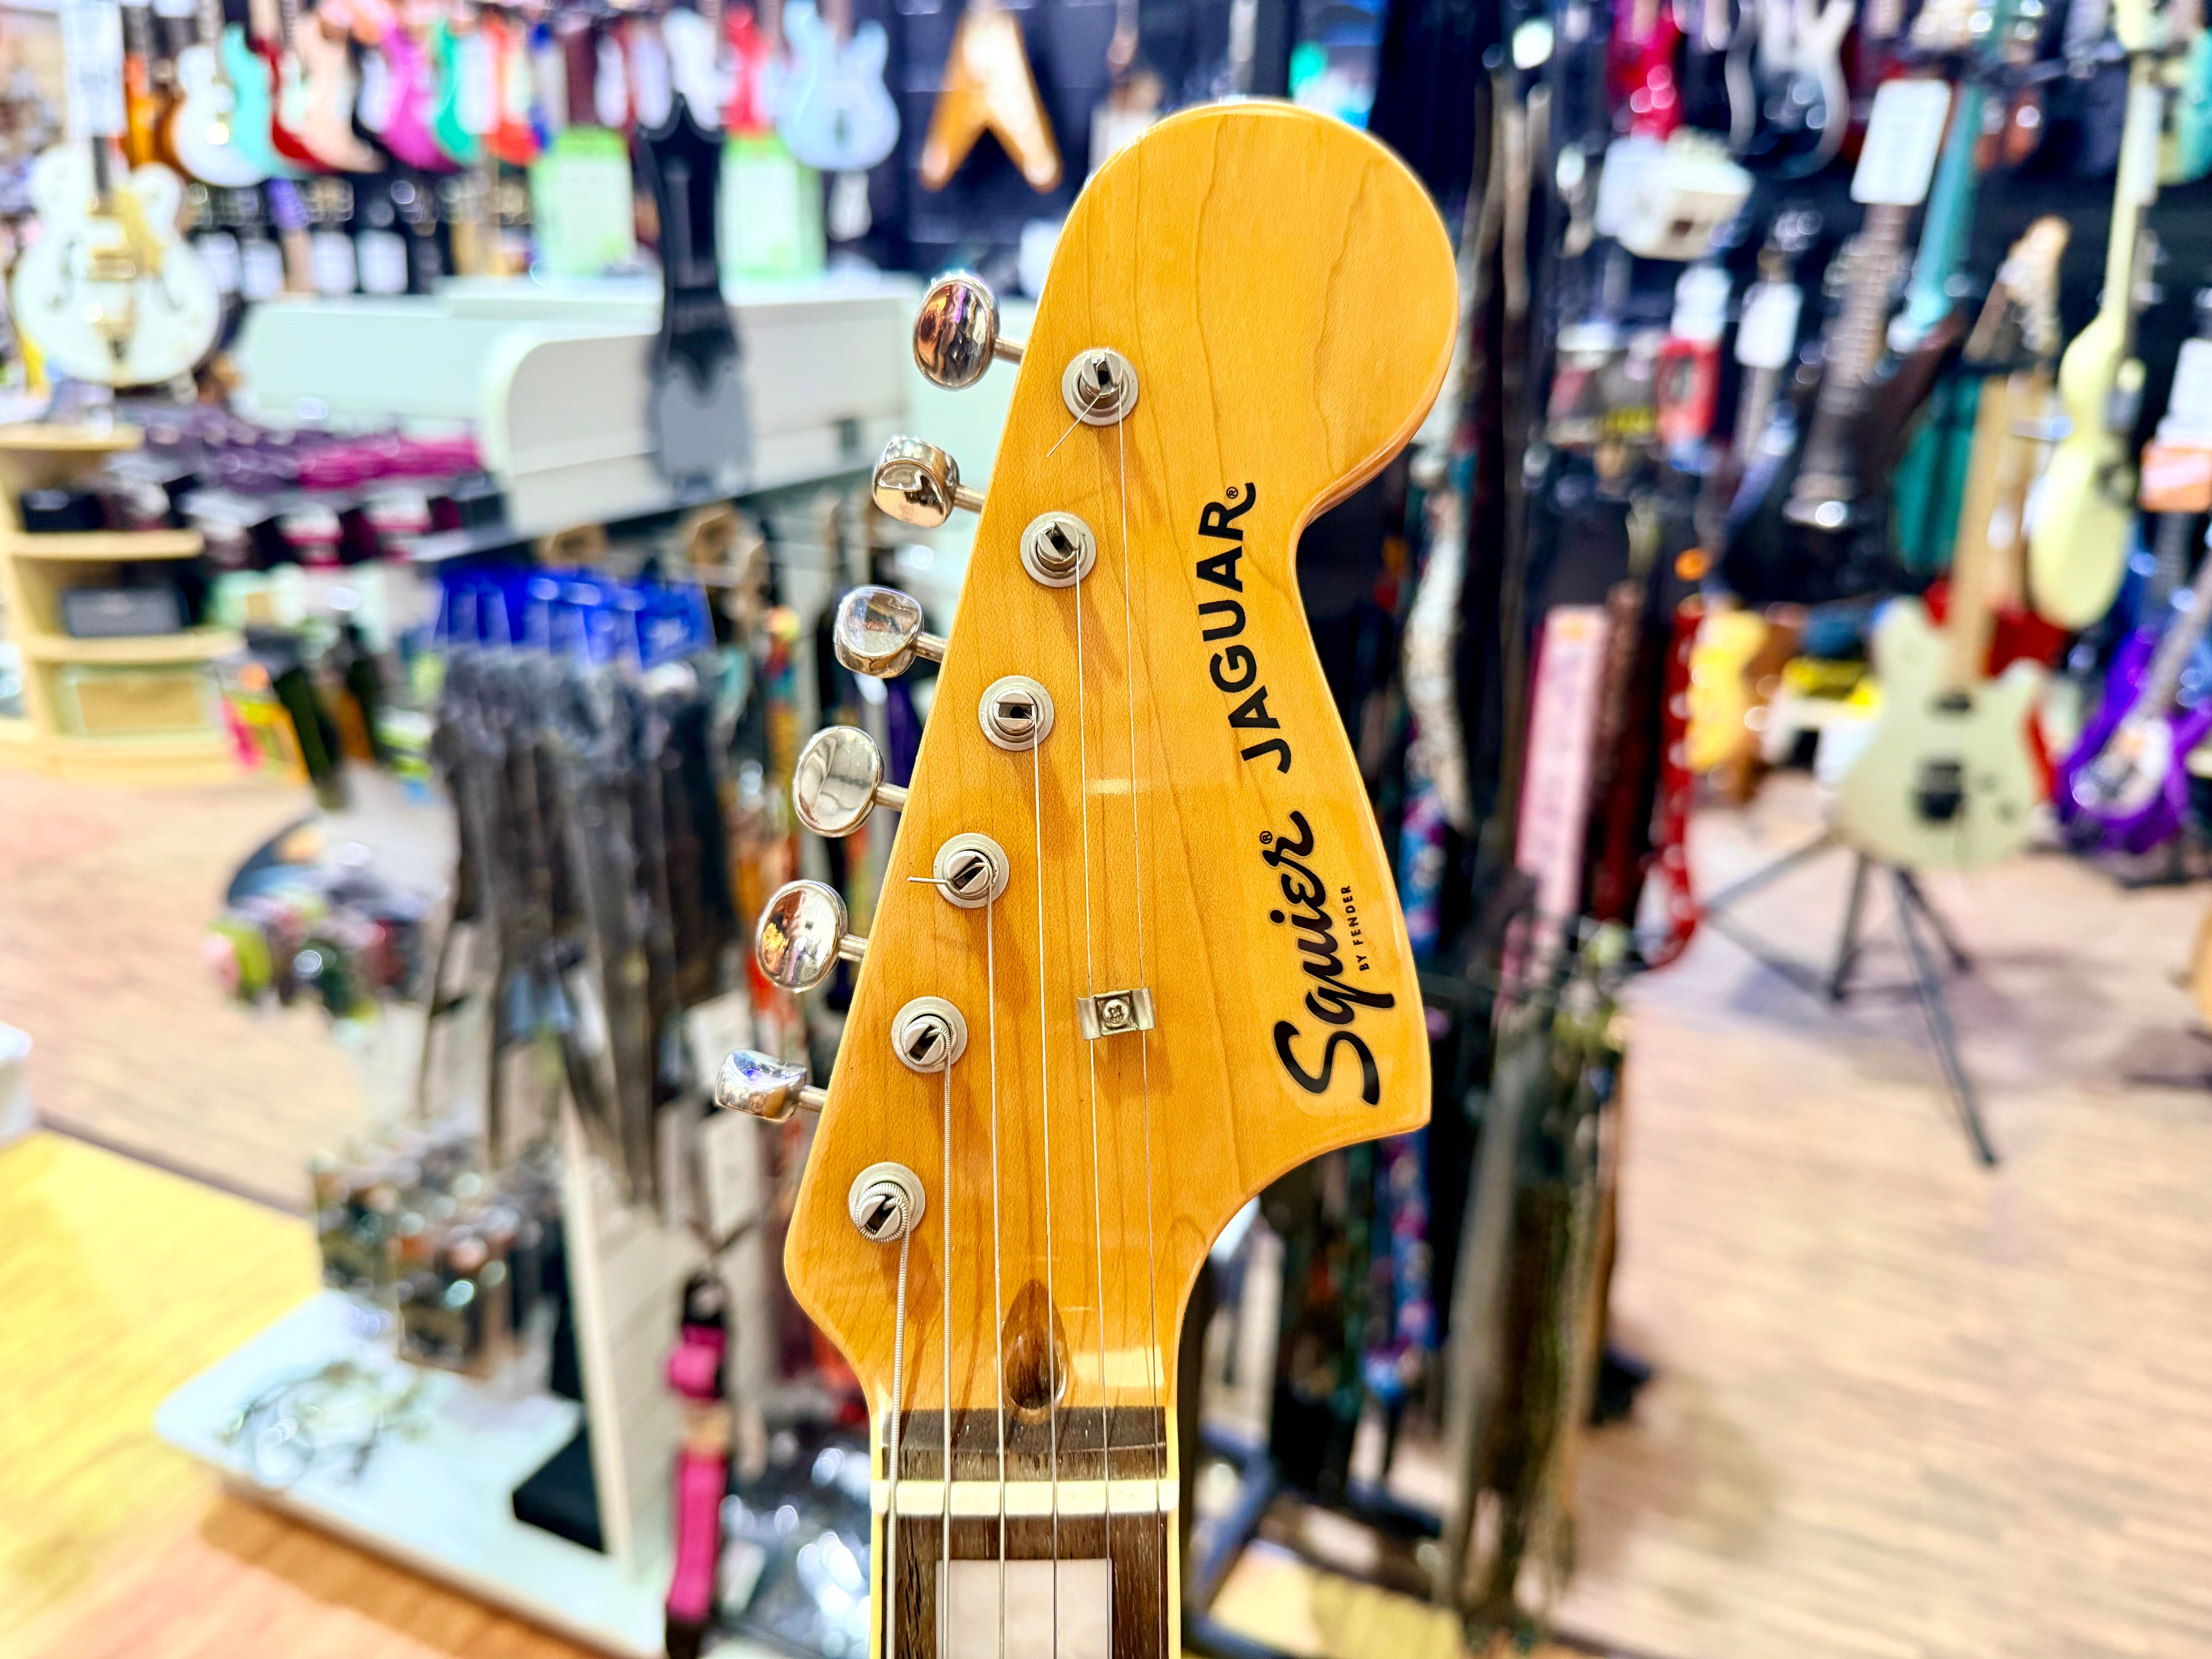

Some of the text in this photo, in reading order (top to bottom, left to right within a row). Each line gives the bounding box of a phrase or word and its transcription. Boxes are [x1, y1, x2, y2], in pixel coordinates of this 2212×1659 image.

[1196, 482, 1291, 774] JAGUAR
[1262, 811, 1395, 1105] Squier
[1341, 885, 1370, 972] BY FENDER
